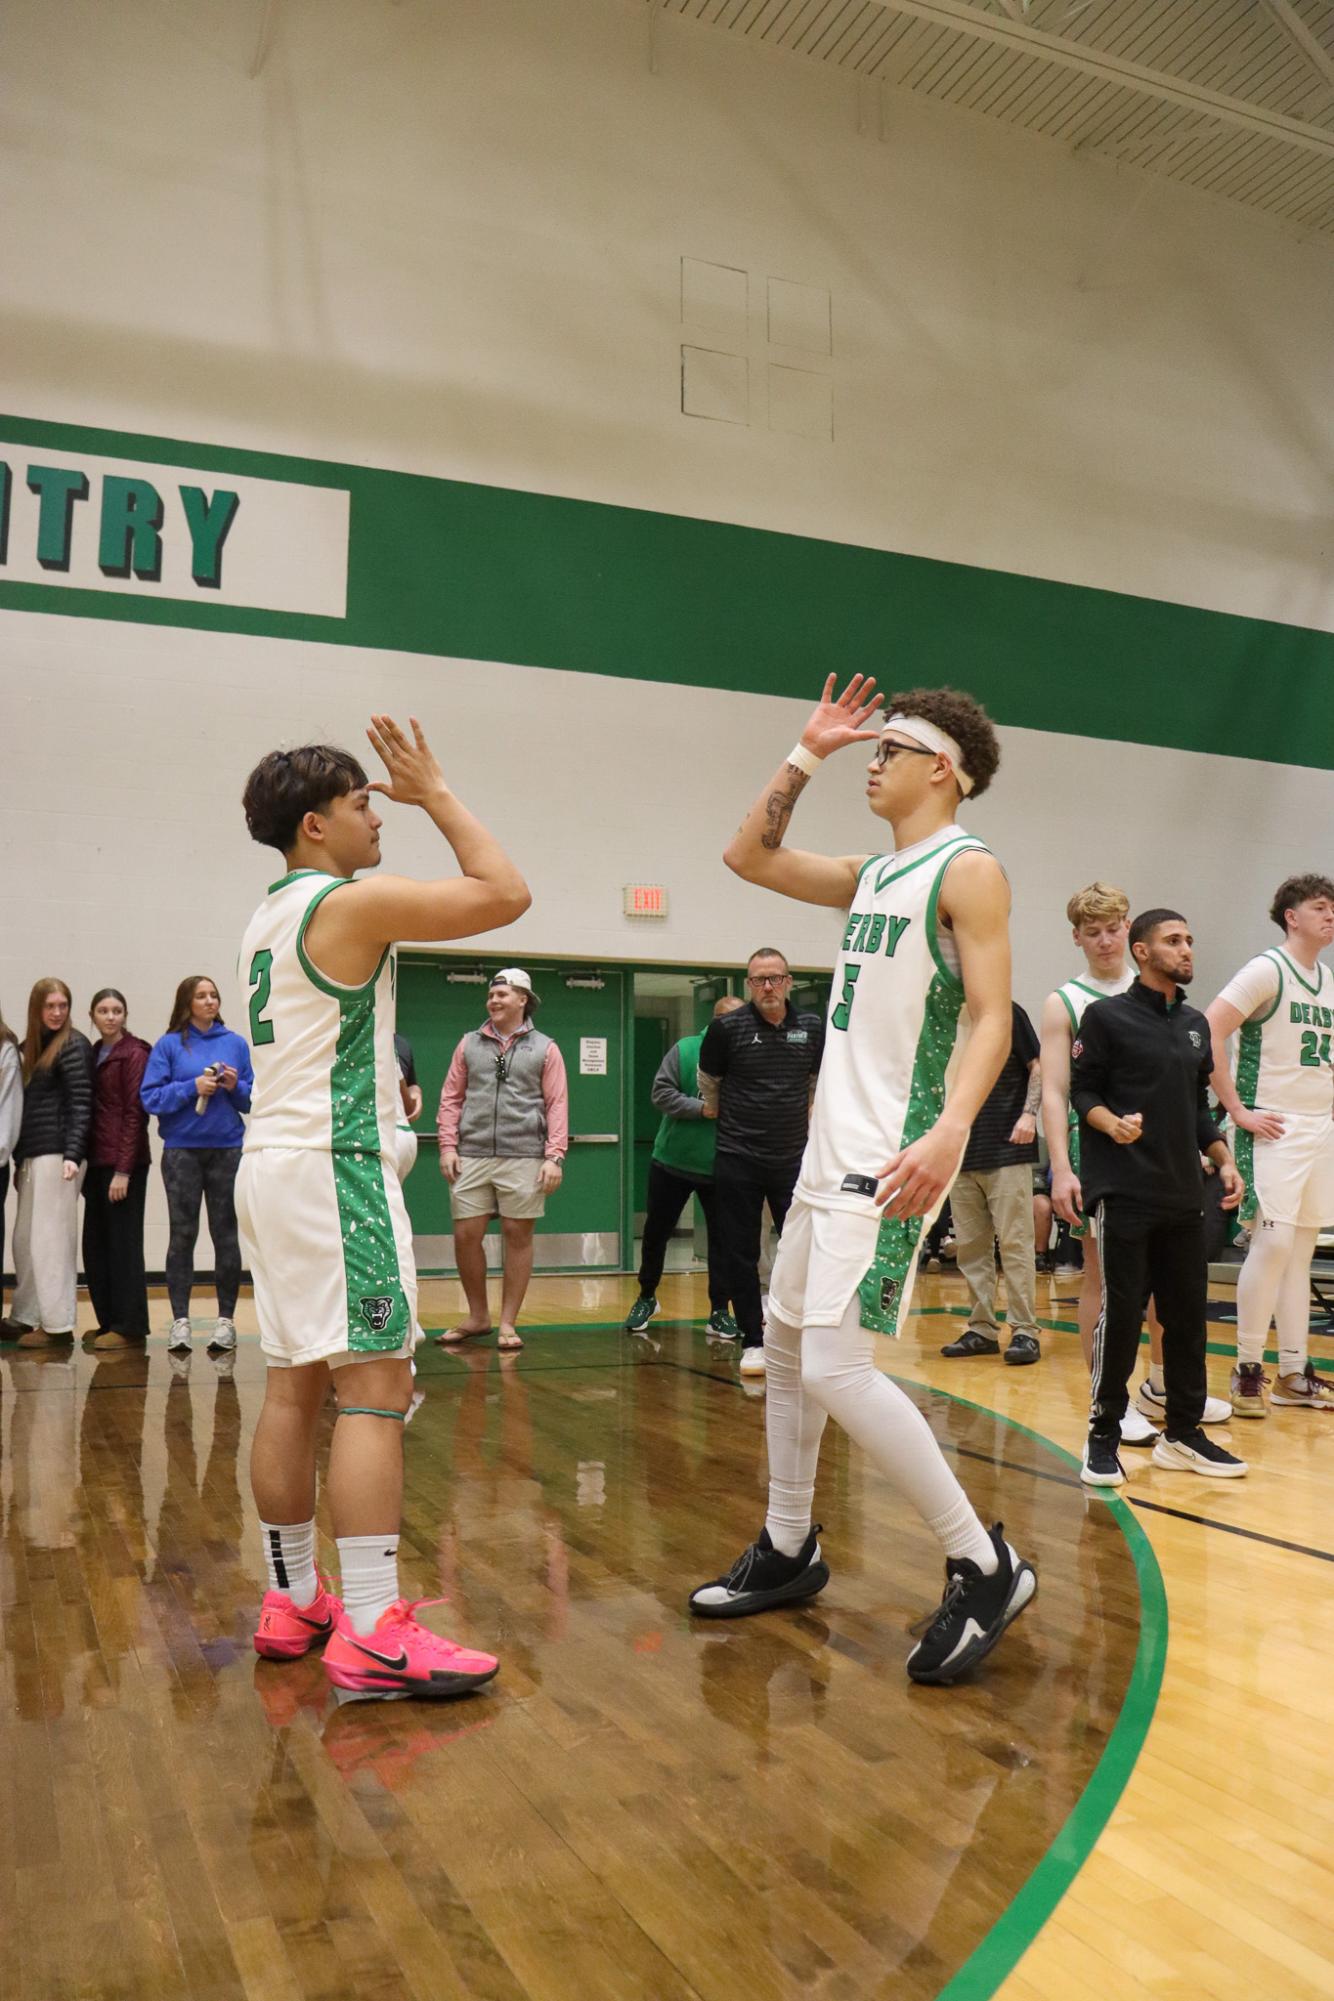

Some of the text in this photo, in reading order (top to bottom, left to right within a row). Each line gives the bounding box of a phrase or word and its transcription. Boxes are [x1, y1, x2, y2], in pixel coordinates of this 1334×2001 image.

[0, 461, 240, 590] TRY
[634, 887, 662, 911] EXIT
[249, 948, 275, 1046] 2
[831, 963, 861, 1031] 5
[864, 1182, 871, 1190] L
